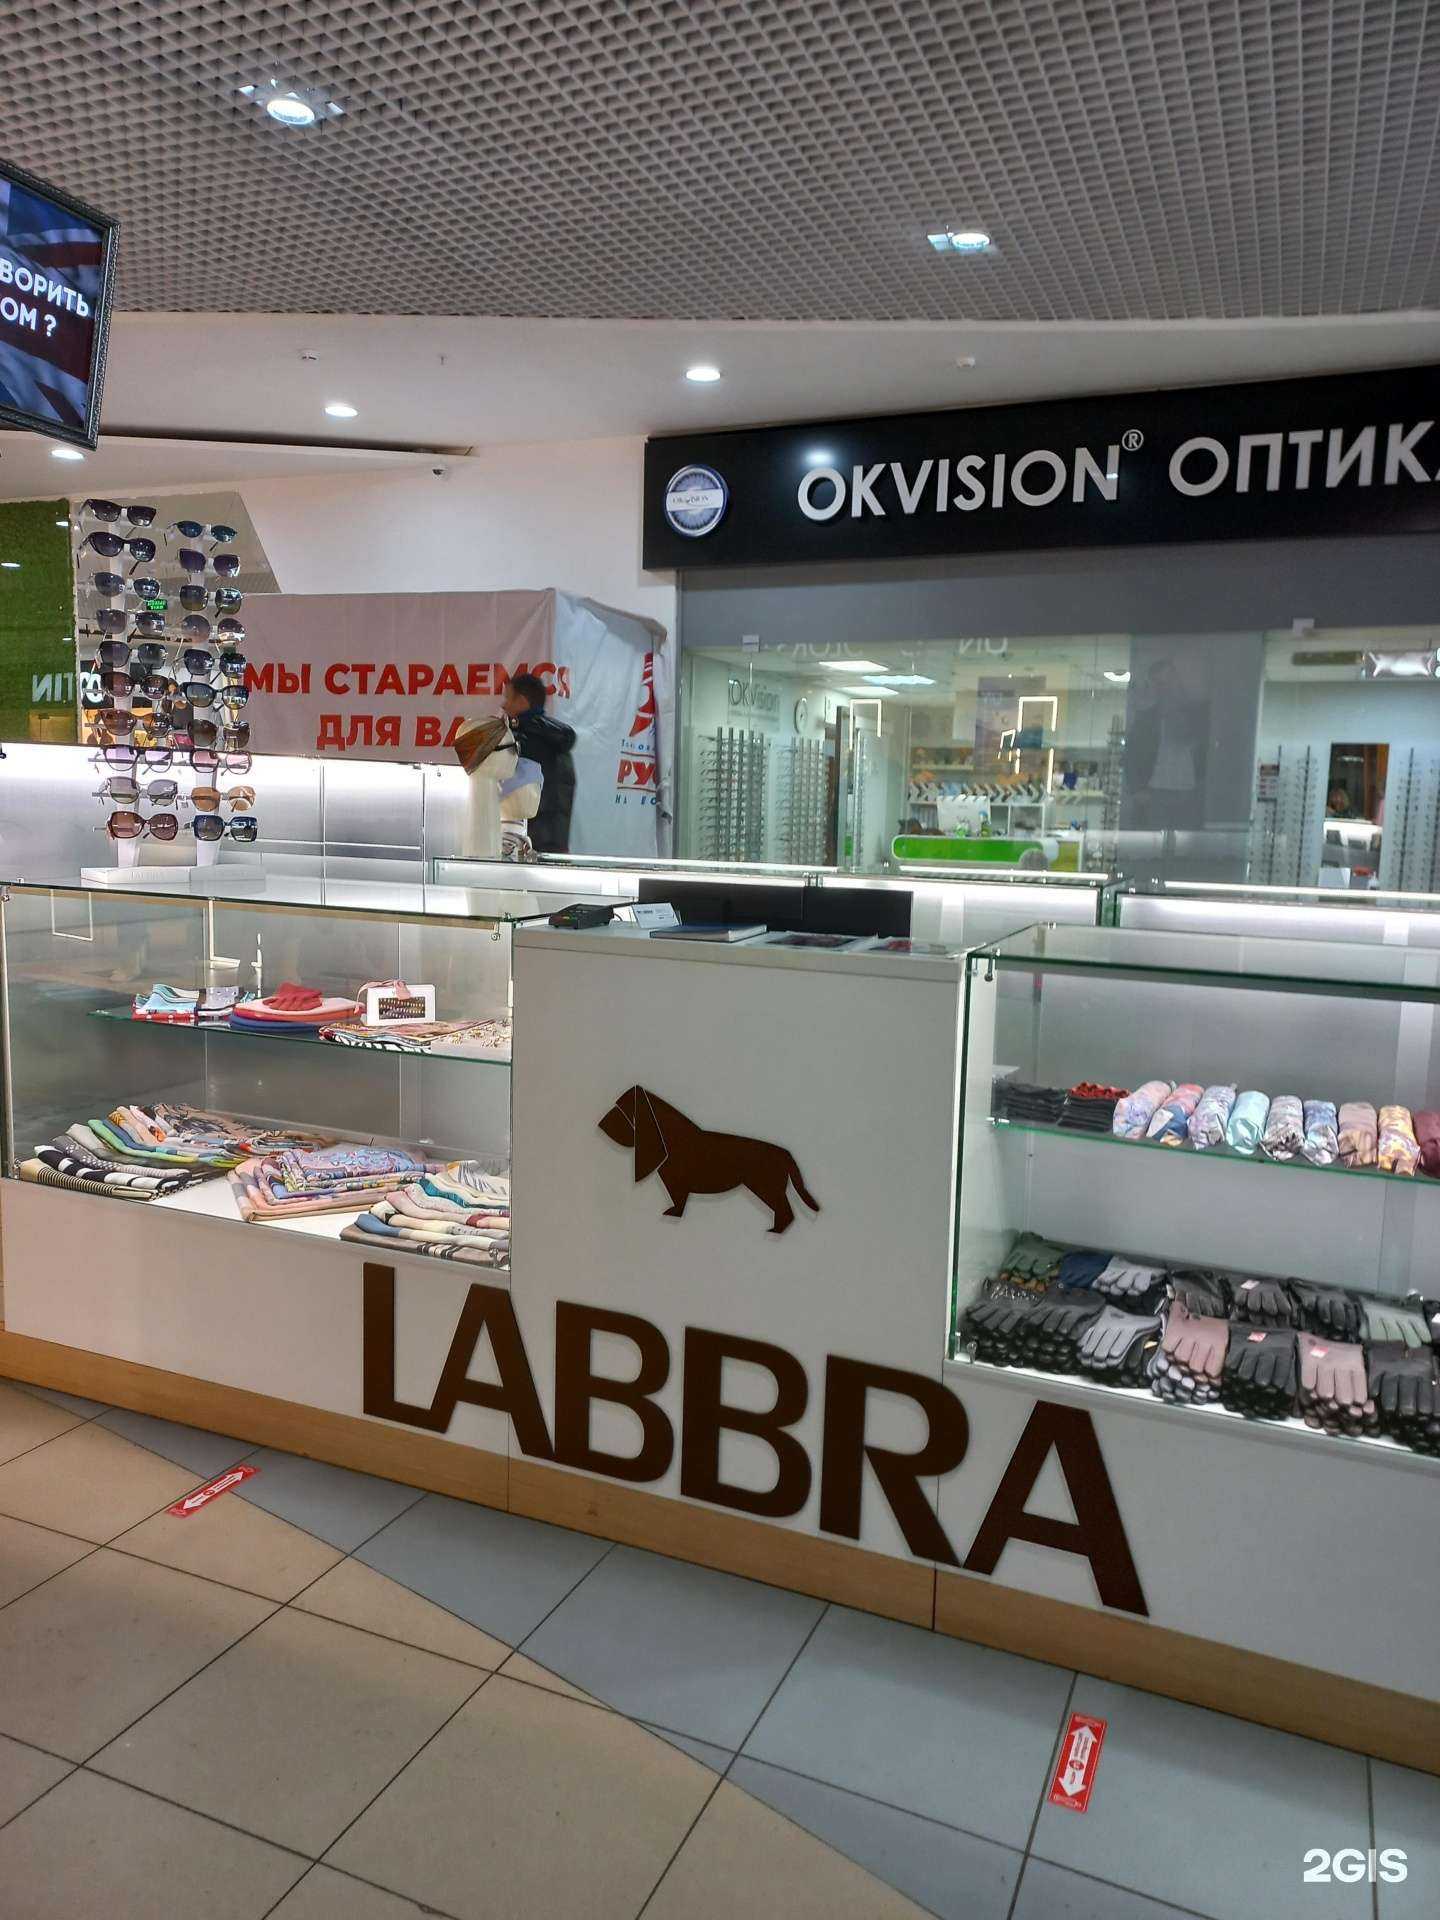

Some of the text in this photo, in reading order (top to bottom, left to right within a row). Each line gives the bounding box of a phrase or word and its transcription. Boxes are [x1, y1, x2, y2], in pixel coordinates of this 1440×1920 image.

[1168, 421, 1440, 497] ОПТИК
[244, 663, 571, 699] МЫ СТАРАЕМСЯ
[317, 714, 402, 751] ДЛЯ
[618, 758, 658, 785] РУ
[363, 1261, 1150, 1618] LABBRA
